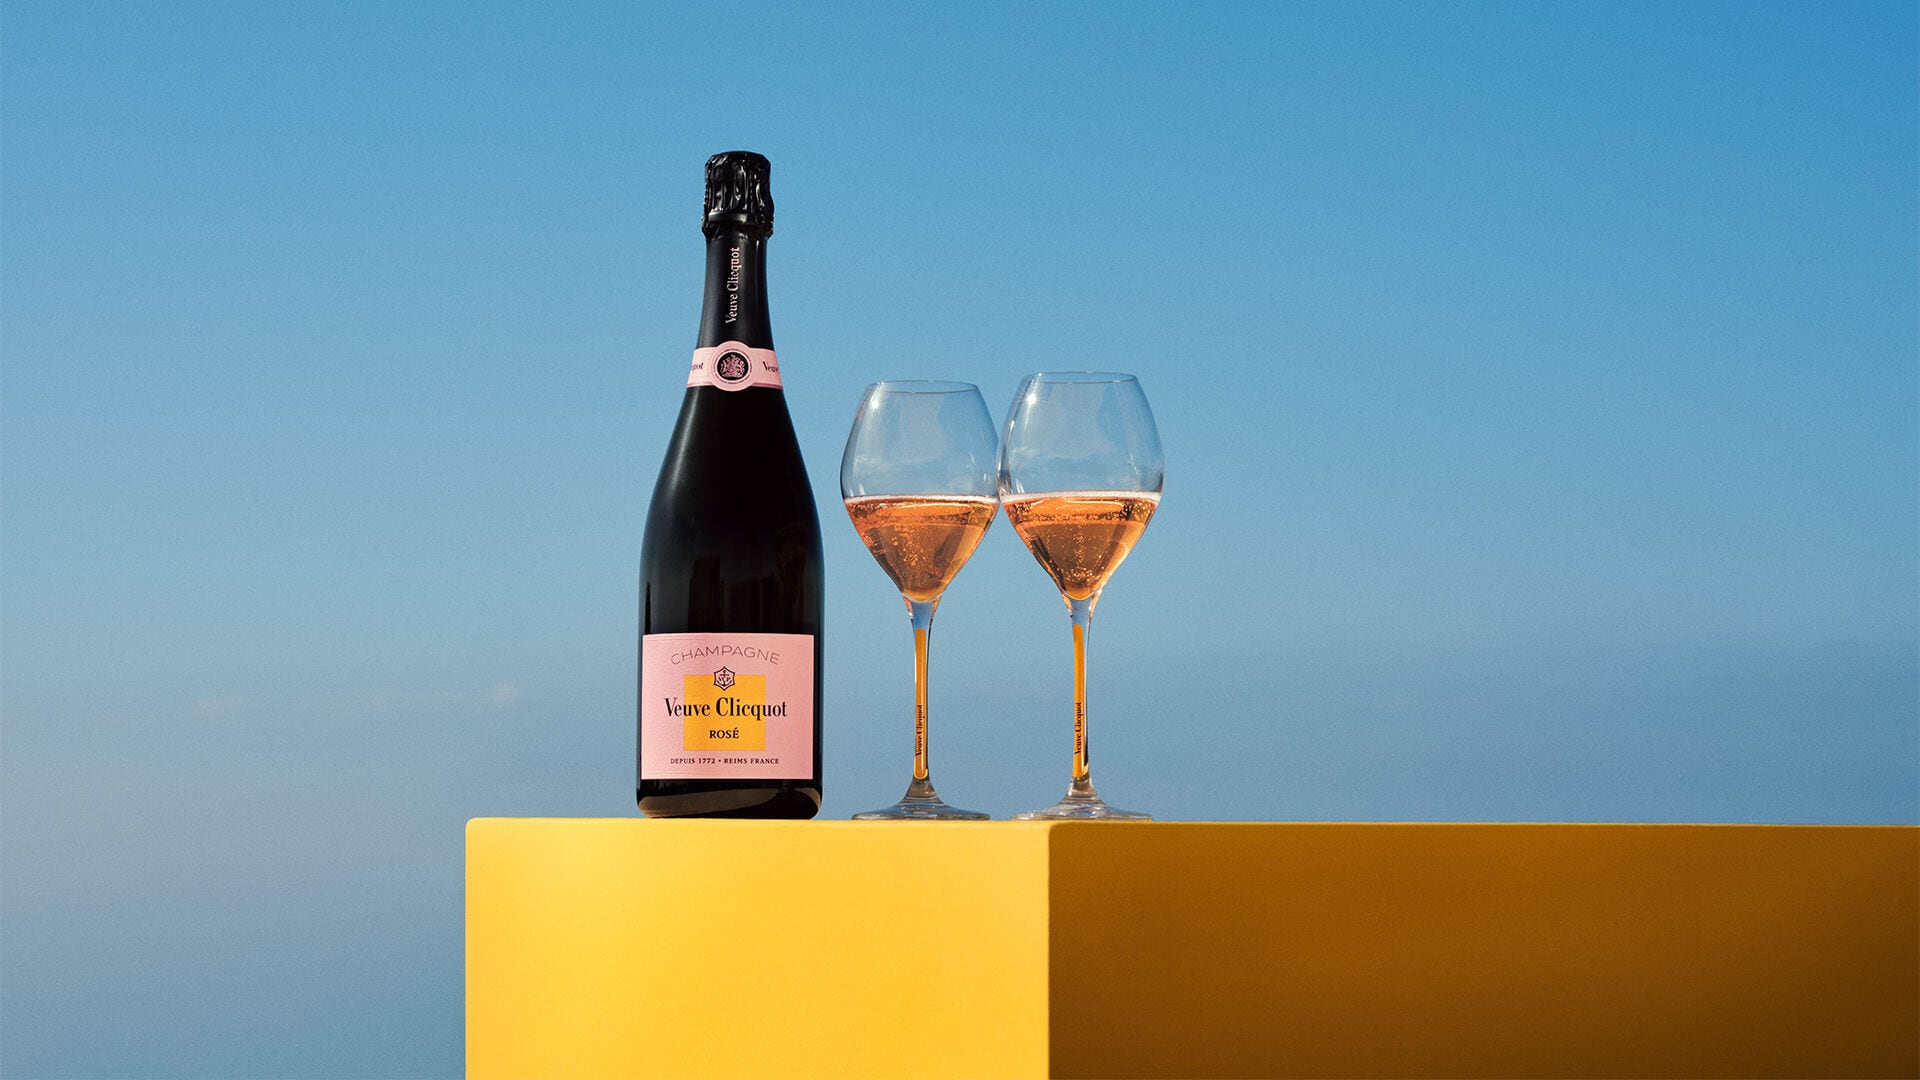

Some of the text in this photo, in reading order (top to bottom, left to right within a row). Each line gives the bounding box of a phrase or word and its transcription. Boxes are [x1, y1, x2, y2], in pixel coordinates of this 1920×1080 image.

[725, 247, 742, 323] Veuve Clicquot
[670, 645, 780, 665] CHAMPAGNE
[664, 697, 787, 721] Veuve Clicquot
[709, 727, 740, 739] ROSÉ
[670, 757, 780, 765] DEPUIS 1772 REIMS FRANCE
